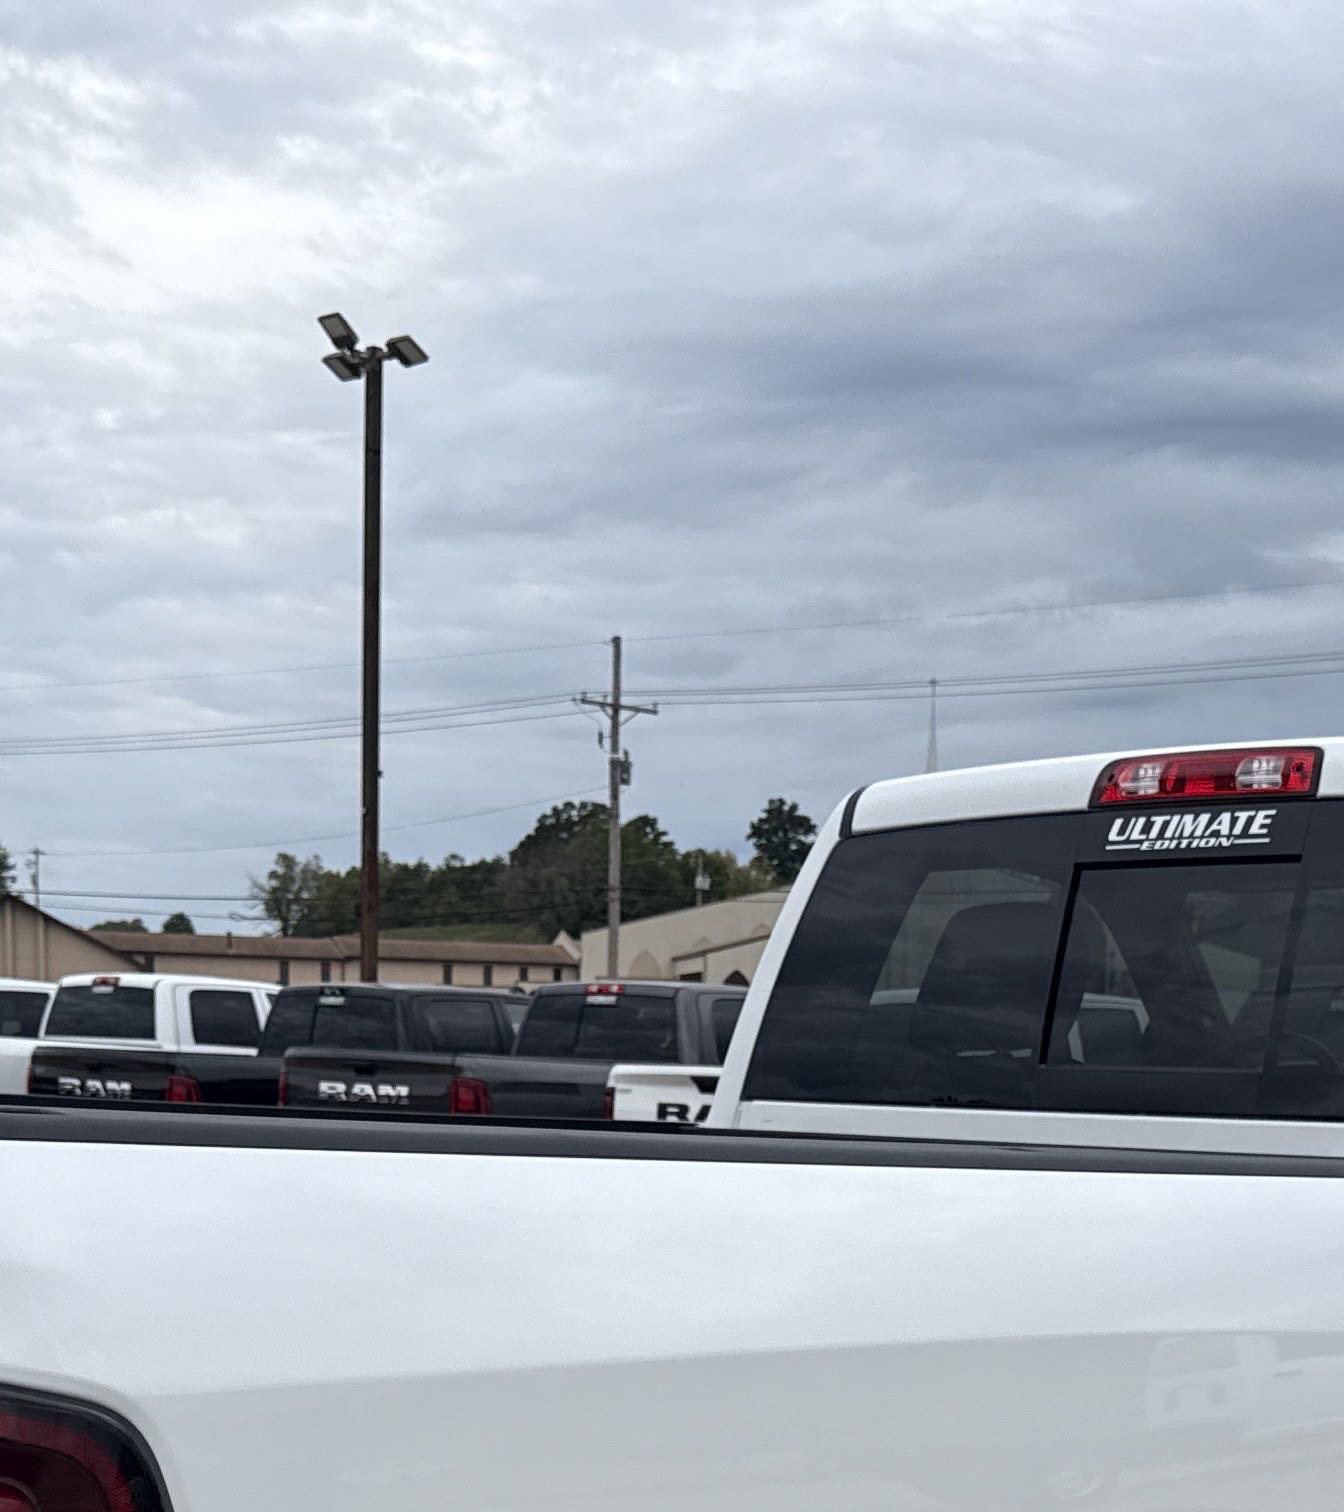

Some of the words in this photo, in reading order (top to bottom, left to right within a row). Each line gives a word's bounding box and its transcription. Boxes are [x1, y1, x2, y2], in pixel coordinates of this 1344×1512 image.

[1107, 809, 1277, 842] ULTIMATE
[1140, 837, 1234, 851] EDITION
[58, 1076, 132, 1099] RAM
[318, 1080, 410, 1105] RAM
